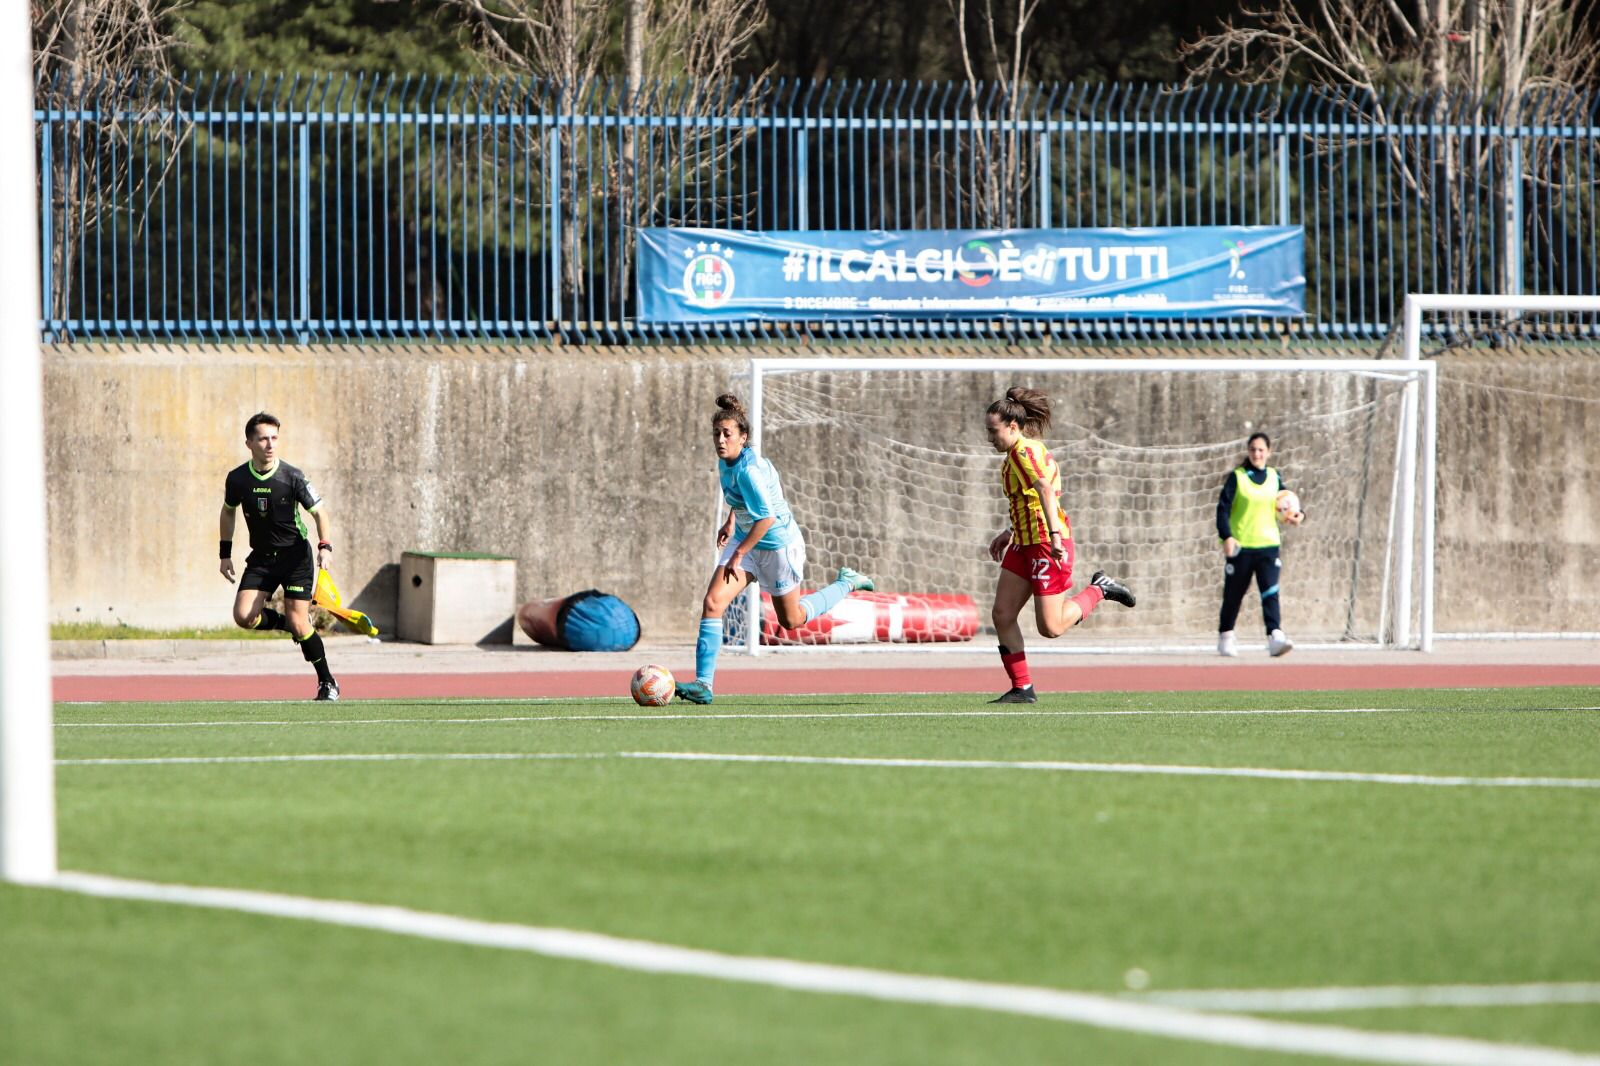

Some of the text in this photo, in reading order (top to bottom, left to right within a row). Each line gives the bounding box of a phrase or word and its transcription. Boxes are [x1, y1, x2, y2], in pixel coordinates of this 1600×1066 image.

[1023, 246, 1057, 281] di
[1058, 246, 1169, 281] TUTTI
[795, 297, 858, 309] DICEMBRE
